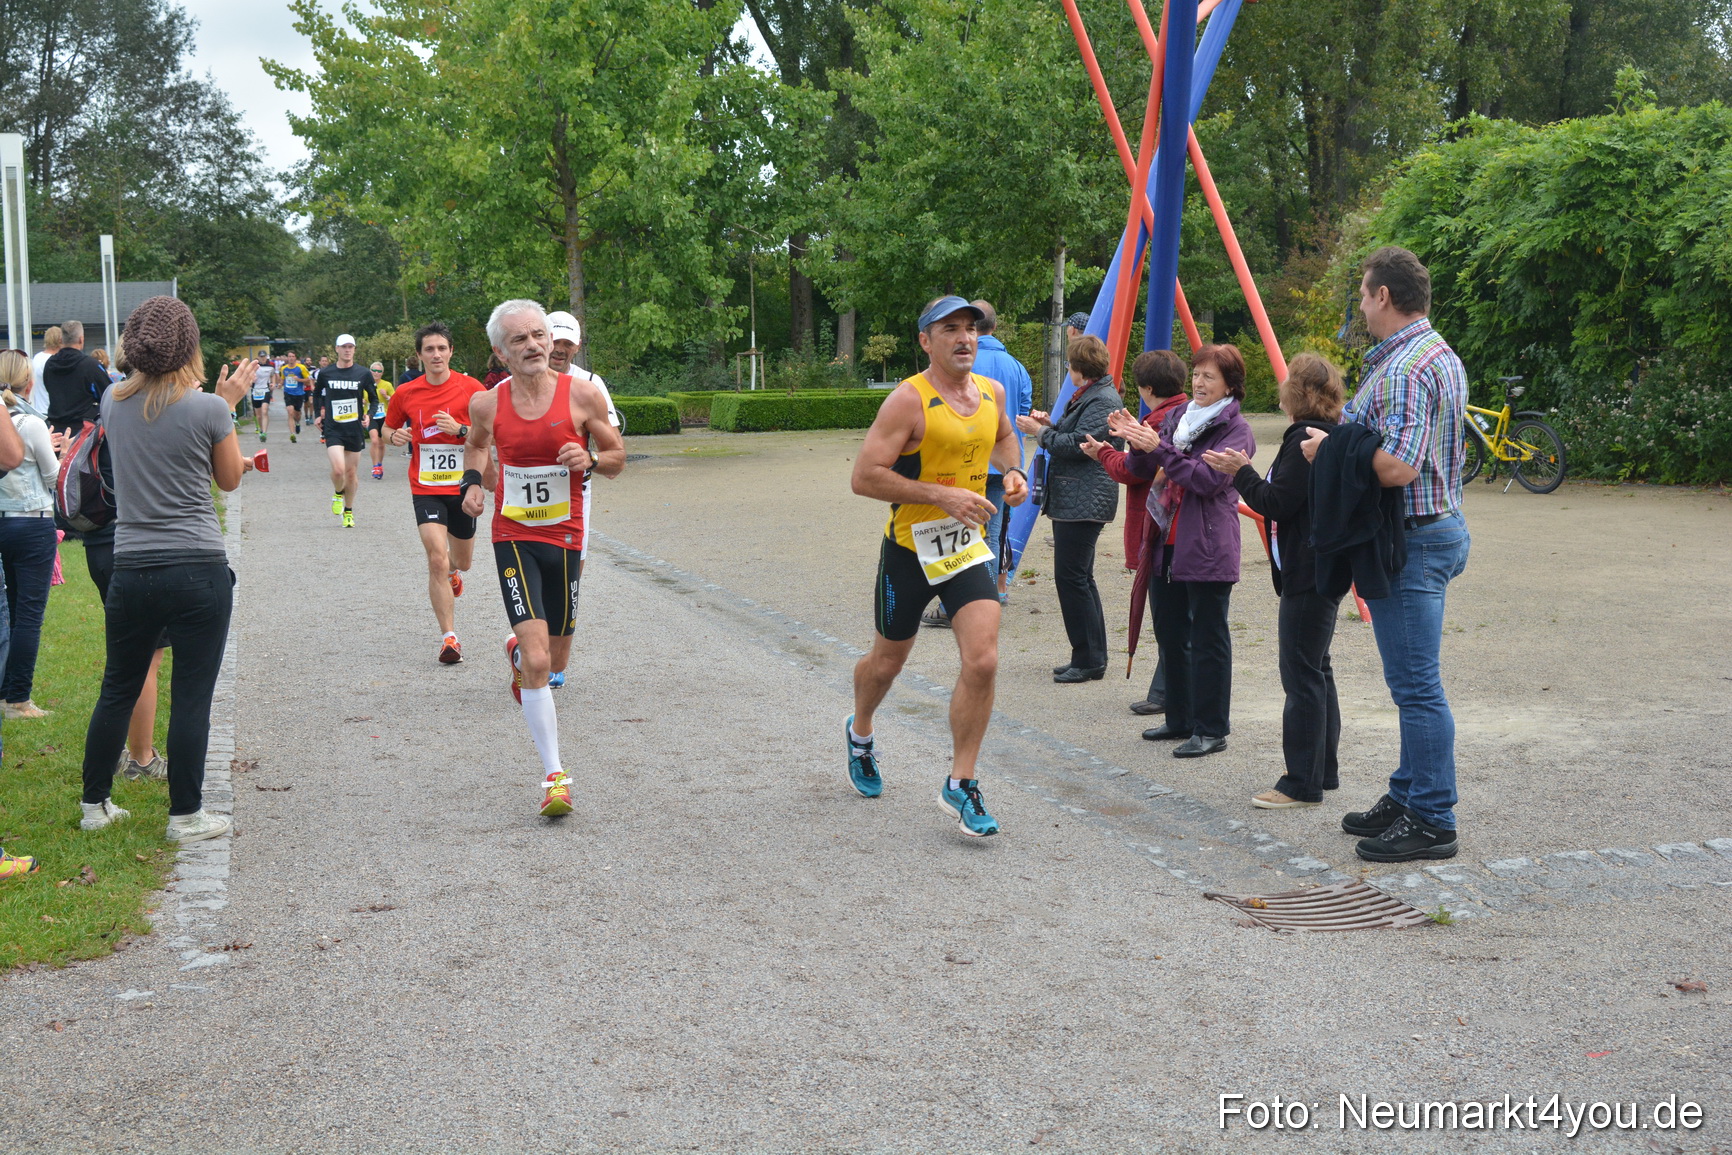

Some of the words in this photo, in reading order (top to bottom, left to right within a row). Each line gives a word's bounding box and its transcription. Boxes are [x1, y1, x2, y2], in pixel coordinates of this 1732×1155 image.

[328, 380, 358, 390] THULE
[338, 405, 352, 414] 291
[429, 454, 456, 470] 126
[505, 470, 522, 480] PARTL
[524, 471, 558, 480] Neumarkt
[522, 482, 550, 504] 15
[526, 508, 548, 518] Willi
[914, 528, 939, 537] PARTL
[940, 520, 964, 531] Neum
[931, 526, 972, 556] 176
[944, 552, 973, 571] Robert
[507, 576, 526, 616] SKINS
